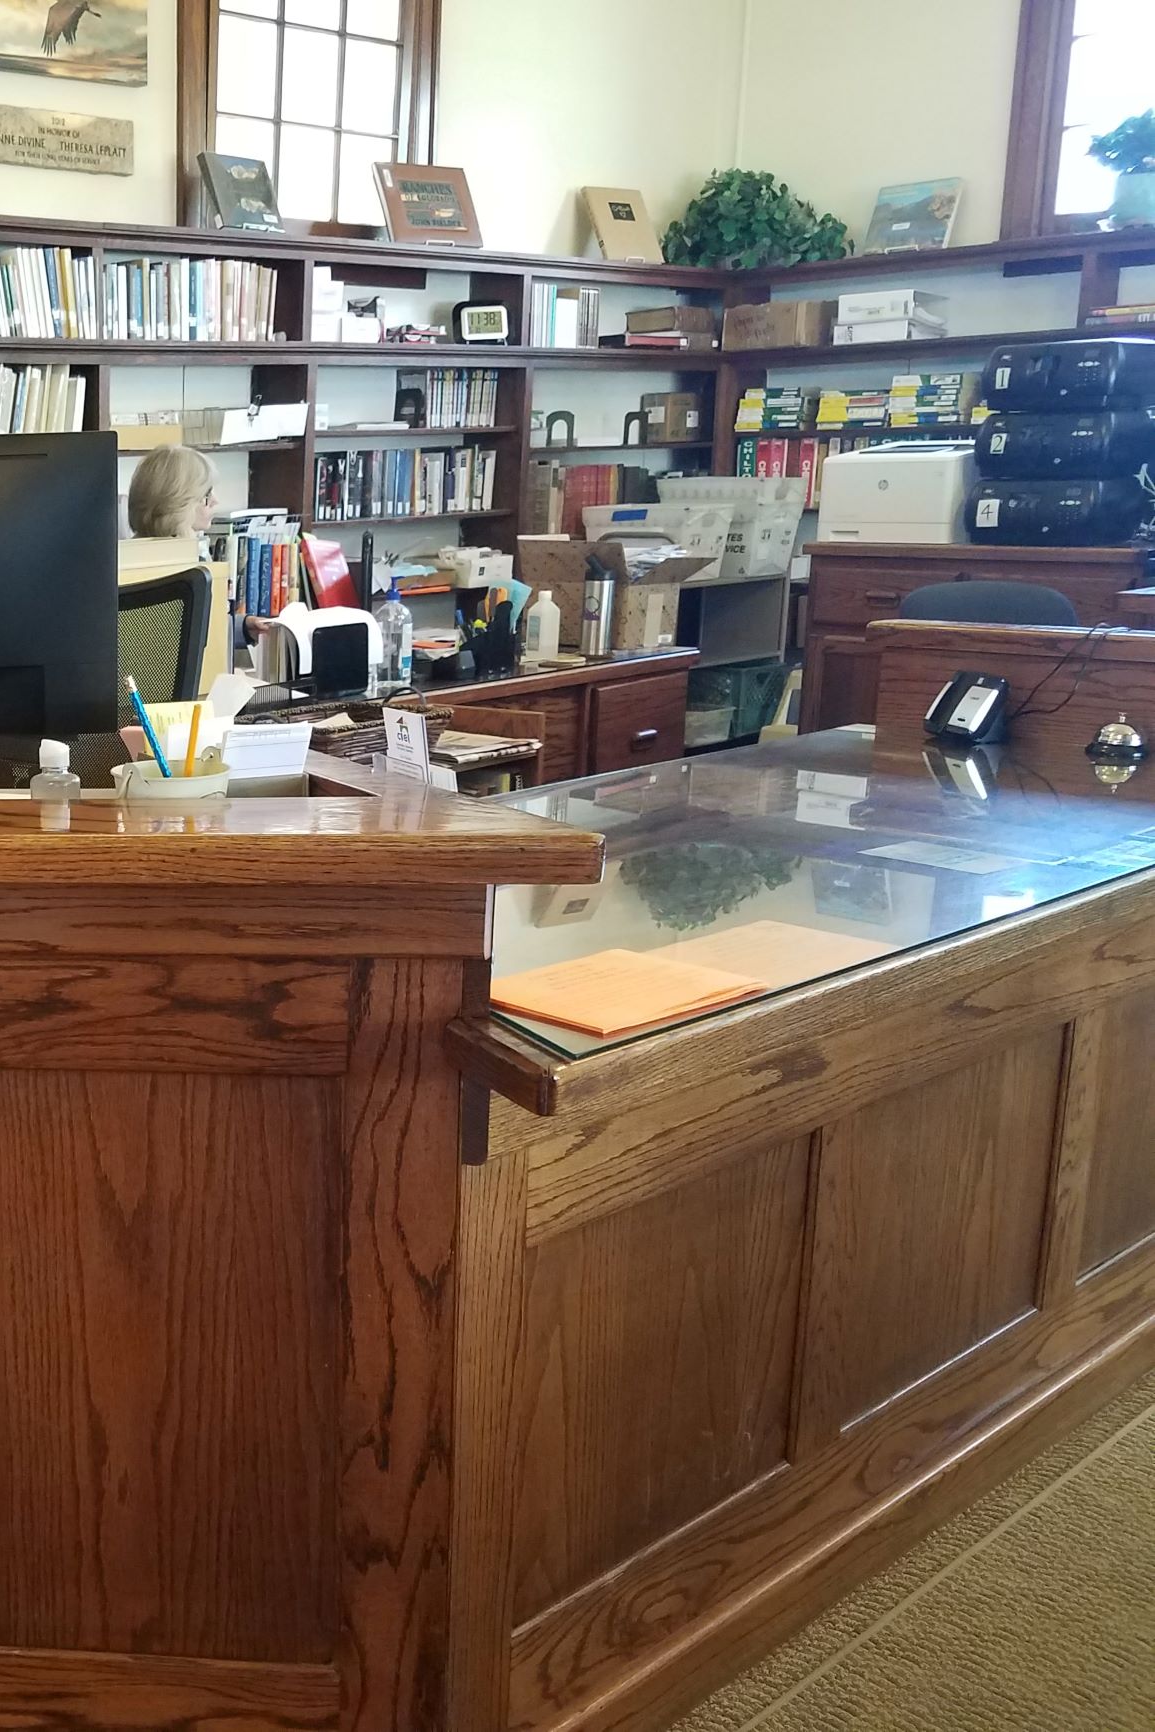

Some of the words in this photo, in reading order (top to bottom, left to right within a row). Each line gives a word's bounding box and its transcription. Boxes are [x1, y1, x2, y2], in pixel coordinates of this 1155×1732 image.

[18, 135, 45, 149] DIVINE
[59, 141, 94, 155] THERESA
[999, 370, 1007, 388] 1
[992, 434, 1004, 453] 2
[980, 503, 993, 520] 4
